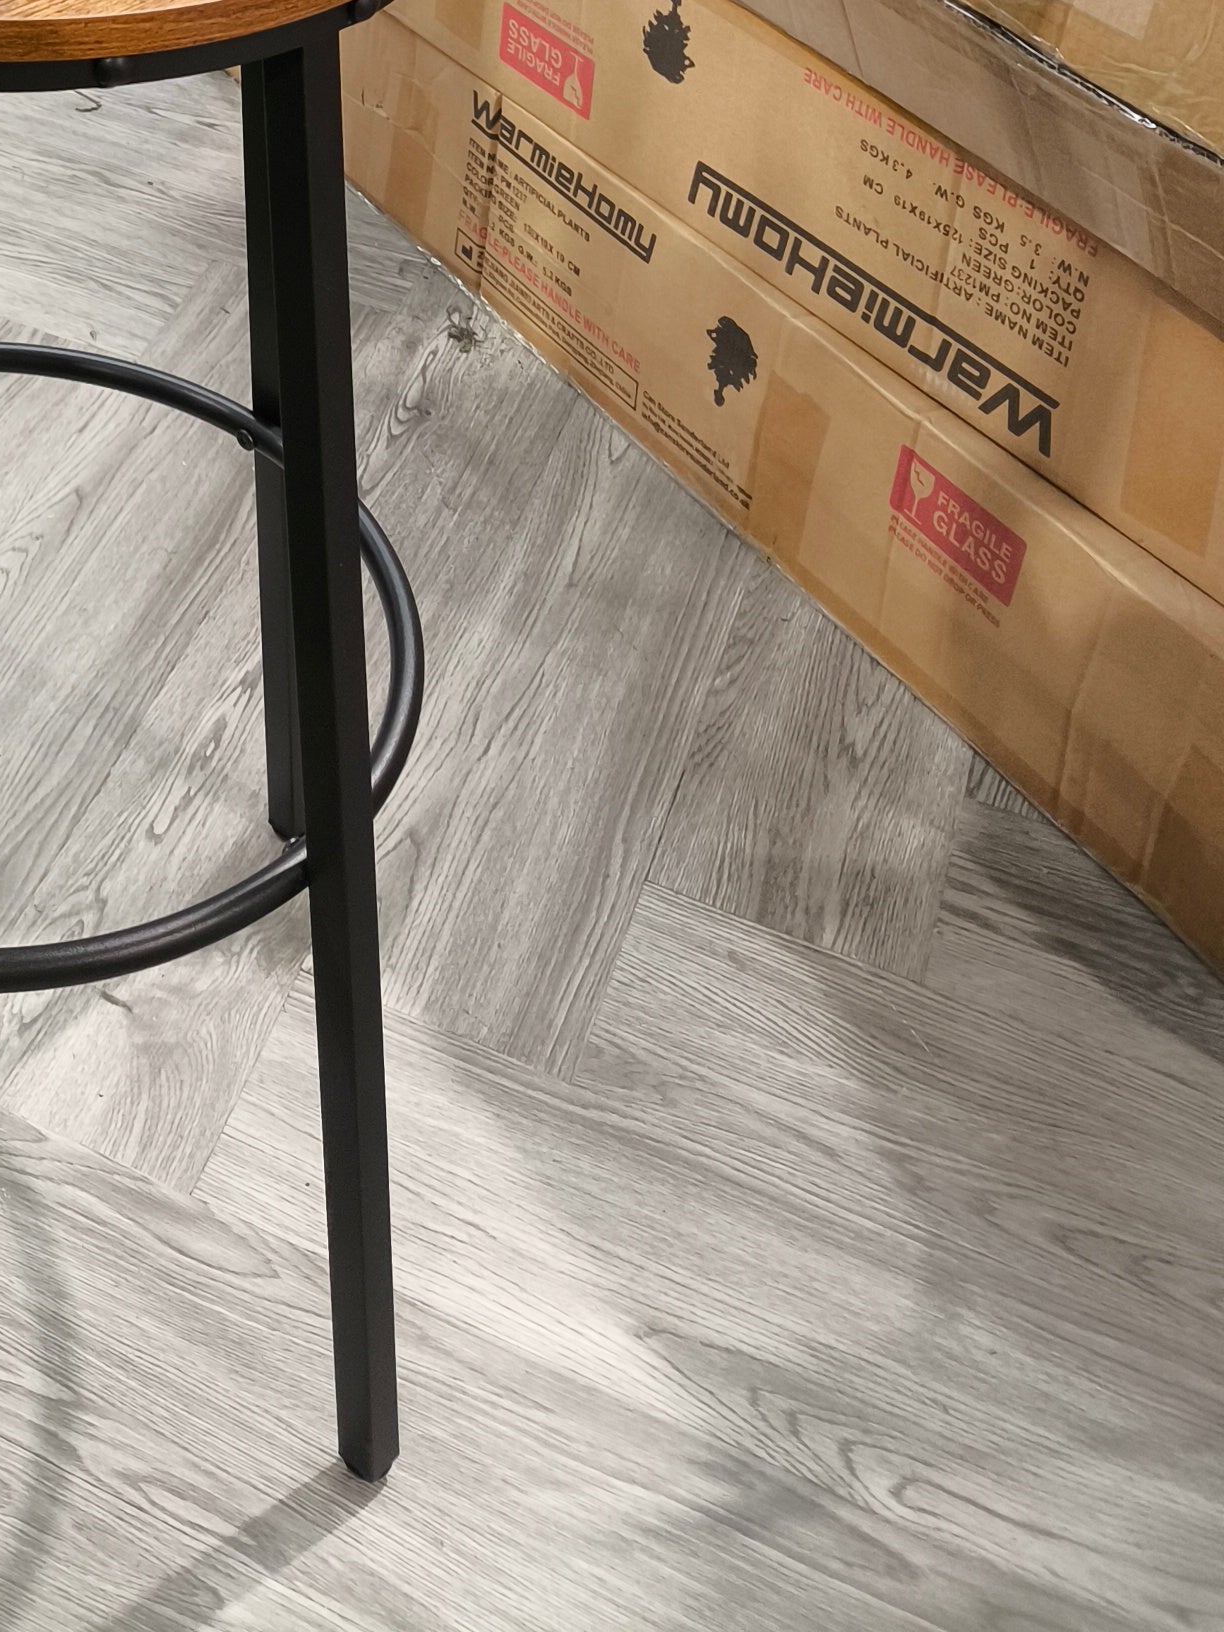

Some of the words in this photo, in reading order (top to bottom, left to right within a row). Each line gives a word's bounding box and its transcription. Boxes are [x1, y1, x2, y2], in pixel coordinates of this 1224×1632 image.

[506, 36, 560, 87] FRAGILE
[507, 17, 562, 71] GLASS
[801, 65, 843, 103] CARE
[843, 91, 884, 129] WITH
[884, 115, 951, 170] HANDLE
[472, 89, 656, 264] WarmieHomy
[861, 172, 884, 196] CM
[513, 172, 557, 216] ARTIFICIAL
[557, 208, 590, 244] PLANTS
[833, 203, 890, 250] PLANTS
[970, 203, 1005, 235] KGS
[976, 224, 1009, 255] PCS
[1018, 232, 1042, 257] 3.5
[890, 240, 973, 305] ARTIFICIAL
[949, 262, 1001, 305] PM1237
[1009, 263, 1082, 320] PACKING
[540, 279, 581, 324] HANDLE
[582, 314, 609, 348] WITH
[611, 338, 641, 375] CARE
[687, 161, 1059, 458] WarmieHomy
[1033, 316, 1073, 353] ITEM
[1030, 332, 1069, 368] ITEM
[930, 506, 1009, 587] GLASS
[936, 488, 1013, 565] FRAGILE
